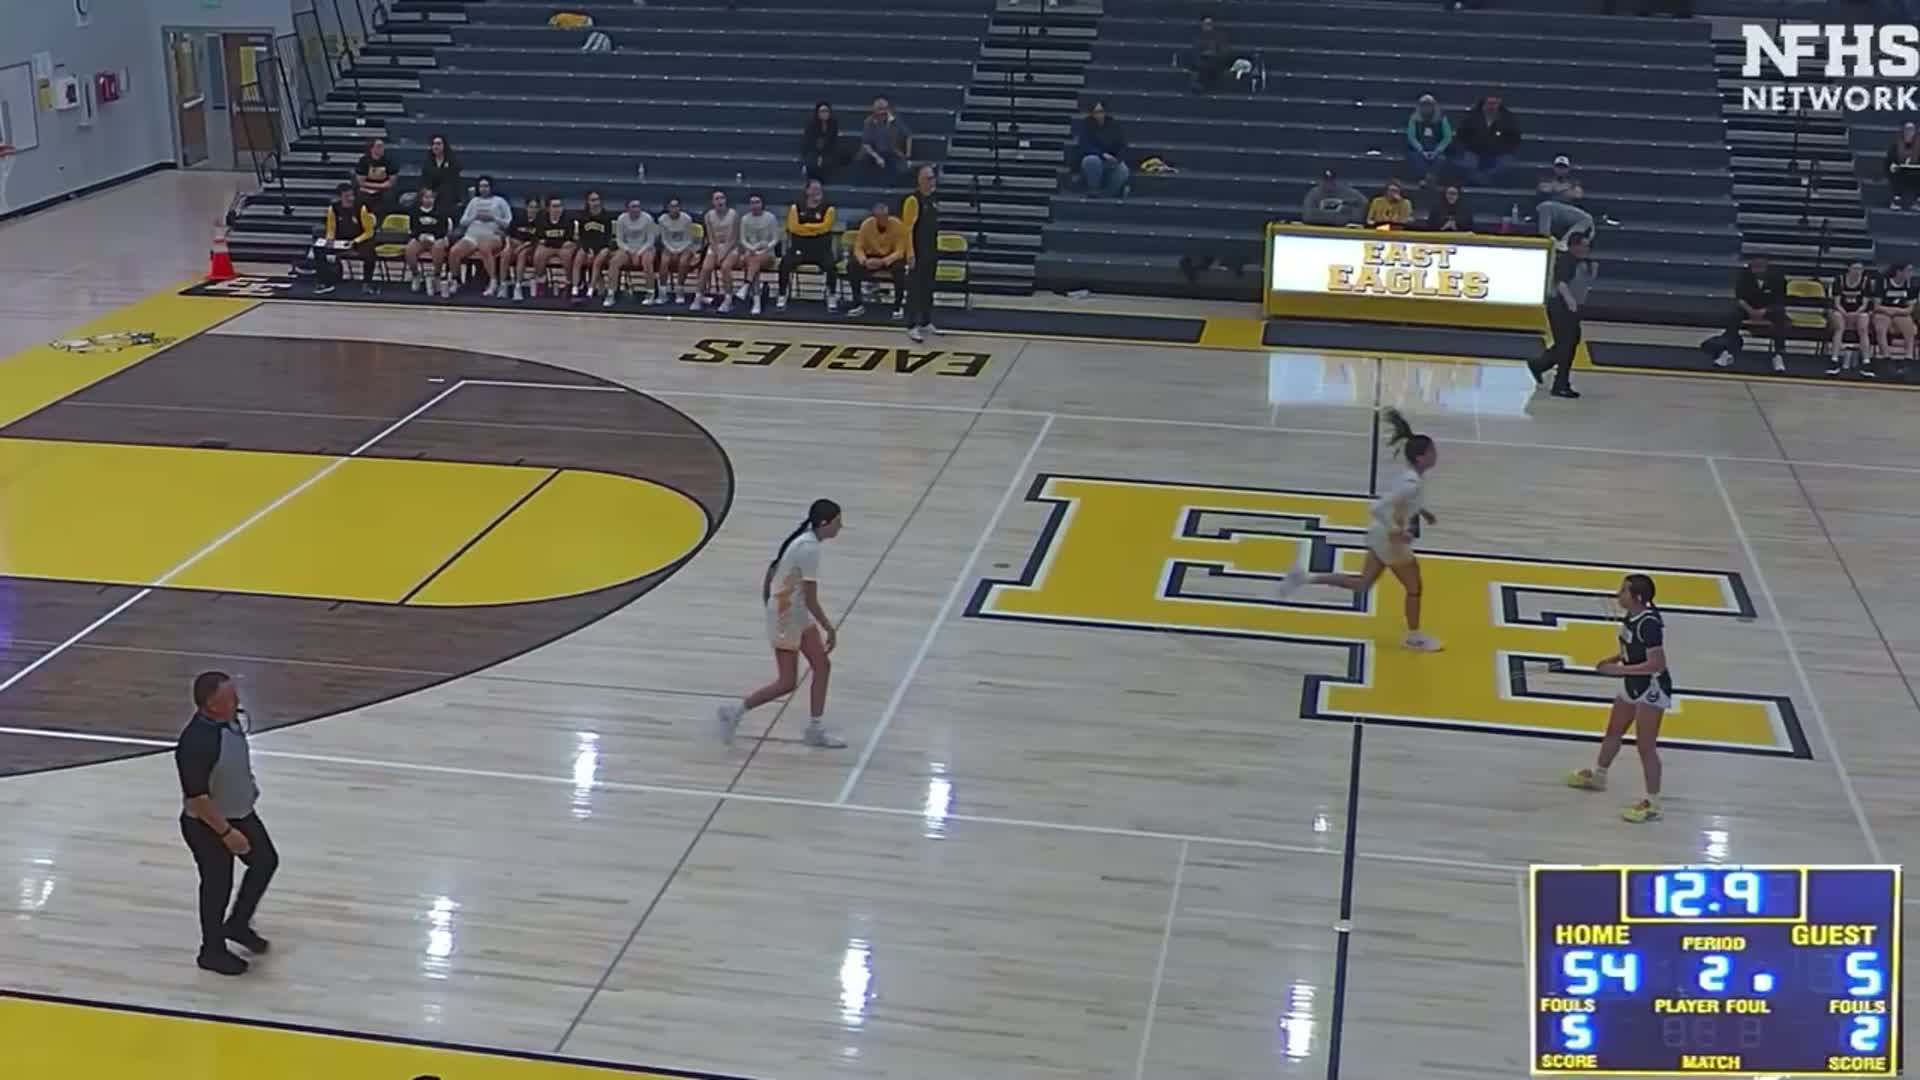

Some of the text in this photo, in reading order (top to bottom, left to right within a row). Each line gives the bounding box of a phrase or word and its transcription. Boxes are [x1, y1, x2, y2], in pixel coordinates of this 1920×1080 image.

[1363, 242, 1456, 269] EAST
[1327, 264, 1489, 299] EAGLES
[679, 339, 992, 378] EAGLES
